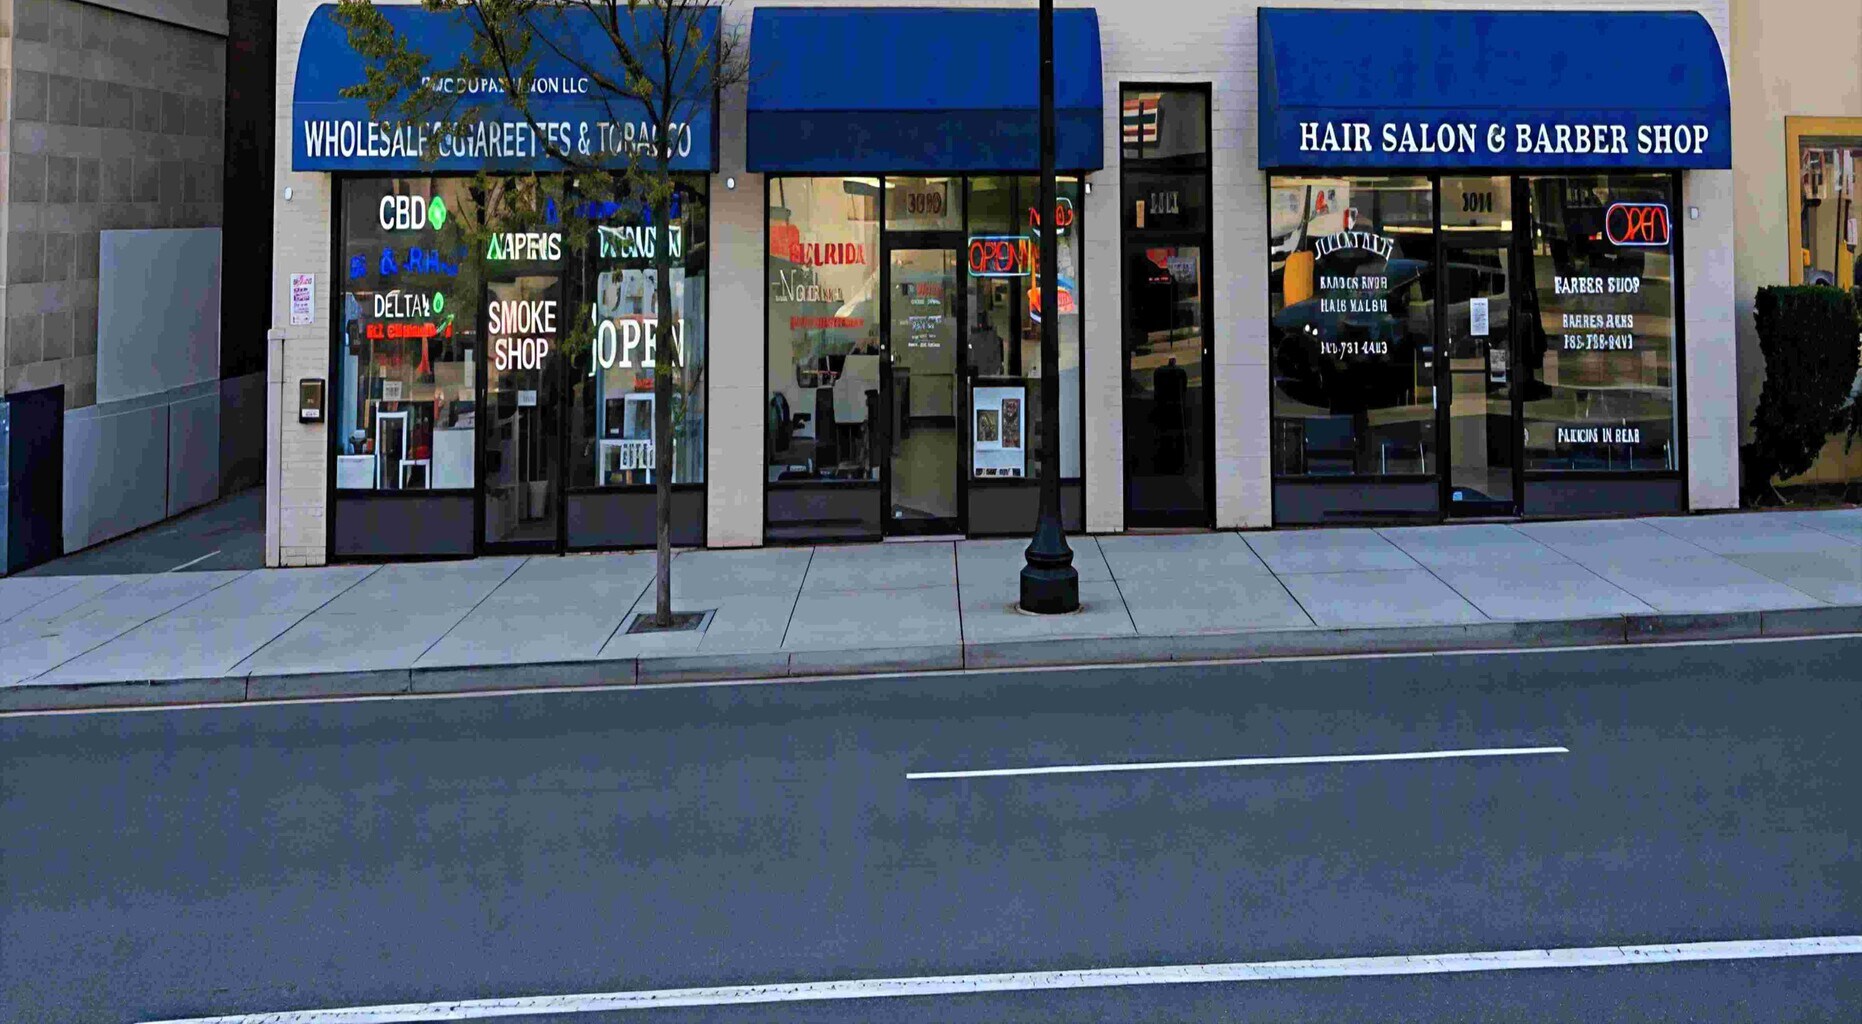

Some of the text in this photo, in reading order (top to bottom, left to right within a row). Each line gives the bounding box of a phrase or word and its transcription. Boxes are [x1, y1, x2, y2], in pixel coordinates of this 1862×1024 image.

[562, 77, 588, 94] LLC
[578, 121, 591, 157] &
[1299, 121, 1709, 154] HAIR SALON & BARBER SHOP
[379, 195, 426, 230] CBD
[1607, 204, 1667, 242] OPEN
[488, 300, 557, 335] SMOKE
[495, 337, 549, 371] SHOP
